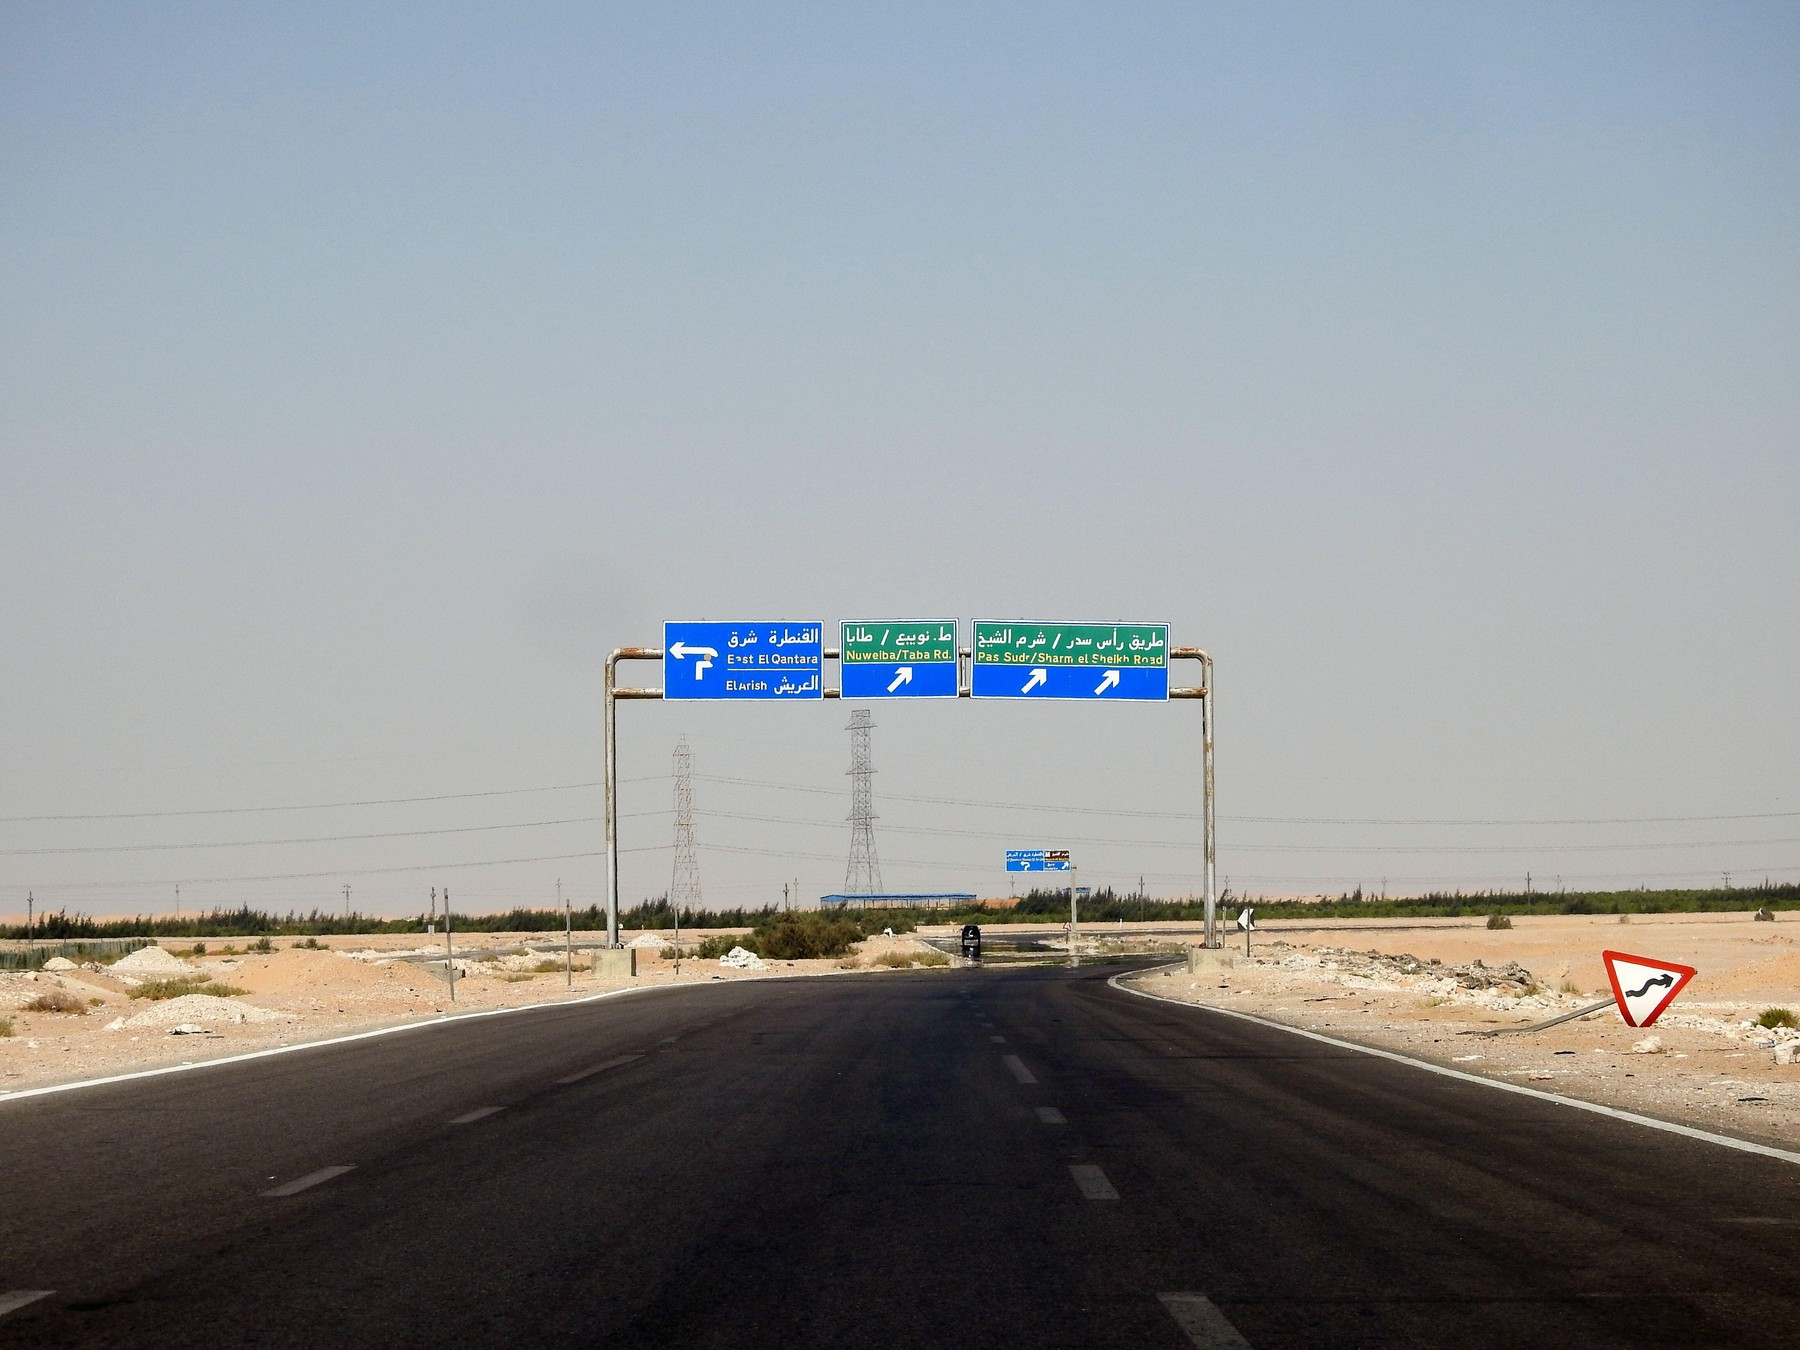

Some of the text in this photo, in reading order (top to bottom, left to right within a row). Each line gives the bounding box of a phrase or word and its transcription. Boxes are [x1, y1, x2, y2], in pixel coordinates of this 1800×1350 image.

[727, 627, 819, 648] القنطرة شرق
[846, 627, 873, 647] طابا
[880, 629, 890, 646] /
[977, 628, 1164, 650] طريق رأس سدر / شرم الشيخ
[758, 653, 770, 665] El
[771, 653, 818, 666] Qantara
[933, 649, 952, 660] Rd.
[1078, 654, 1089, 664] el
[773, 674, 819, 694] العريش
